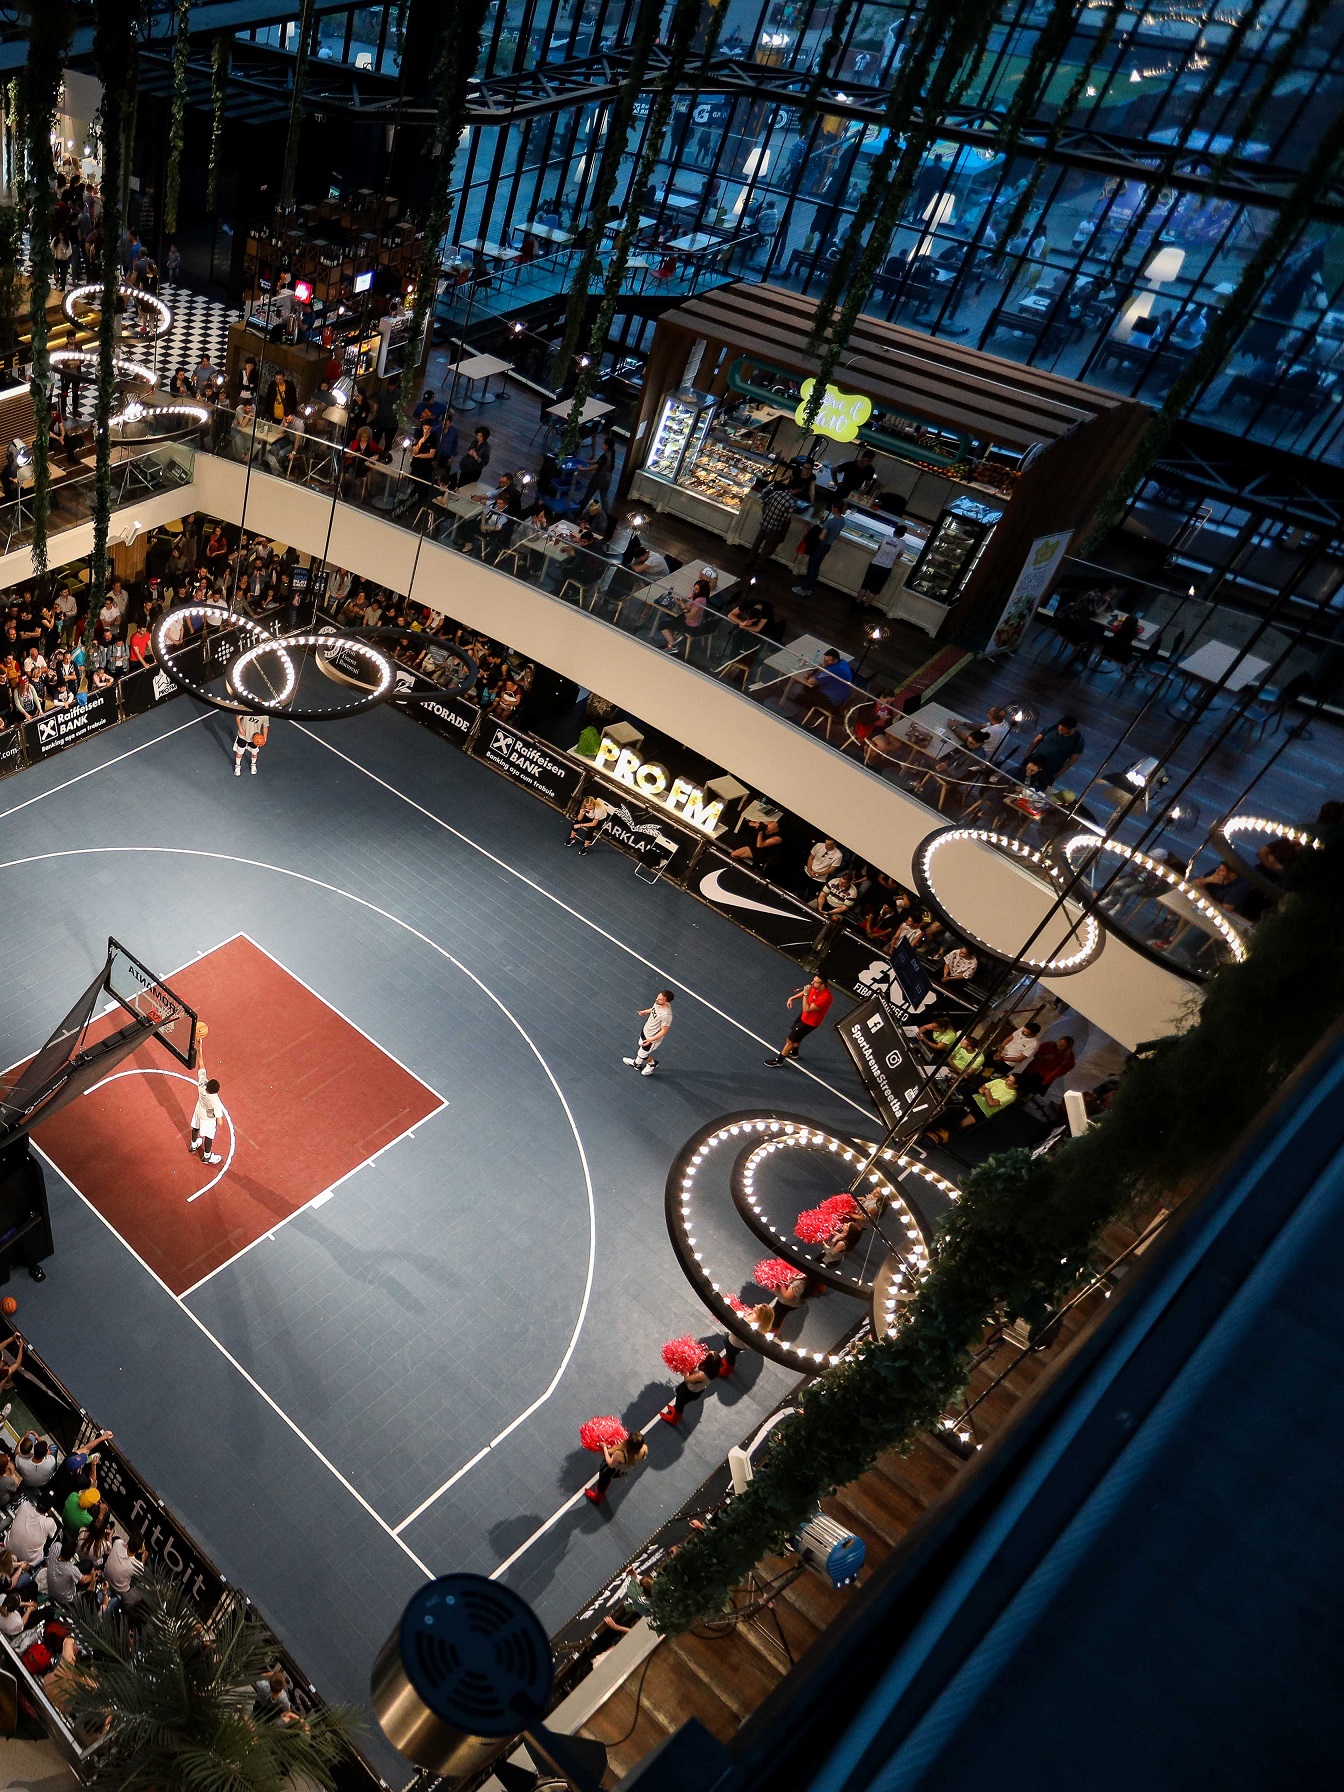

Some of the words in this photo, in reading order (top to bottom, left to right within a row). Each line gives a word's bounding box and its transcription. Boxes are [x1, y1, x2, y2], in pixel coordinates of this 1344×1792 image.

[238, 620, 282, 652] fitit
[57, 697, 105, 724] Raiffeisen
[59, 714, 88, 734] BANK
[420, 701, 470, 732] ATORADE
[486, 751, 510, 770] Banking
[533, 781, 555, 797] trebuie
[510, 752, 543, 777] BANK
[514, 741, 565, 778] Raiffeisen
[594, 738, 666, 794] PRO
[666, 778, 724, 832] FM
[603, 822, 650, 852] ARKLA
[853, 983, 872, 998] FIBA
[851, 1024, 908, 1123] SportArenaStreetbal
[130, 1500, 206, 1601] fitbit
